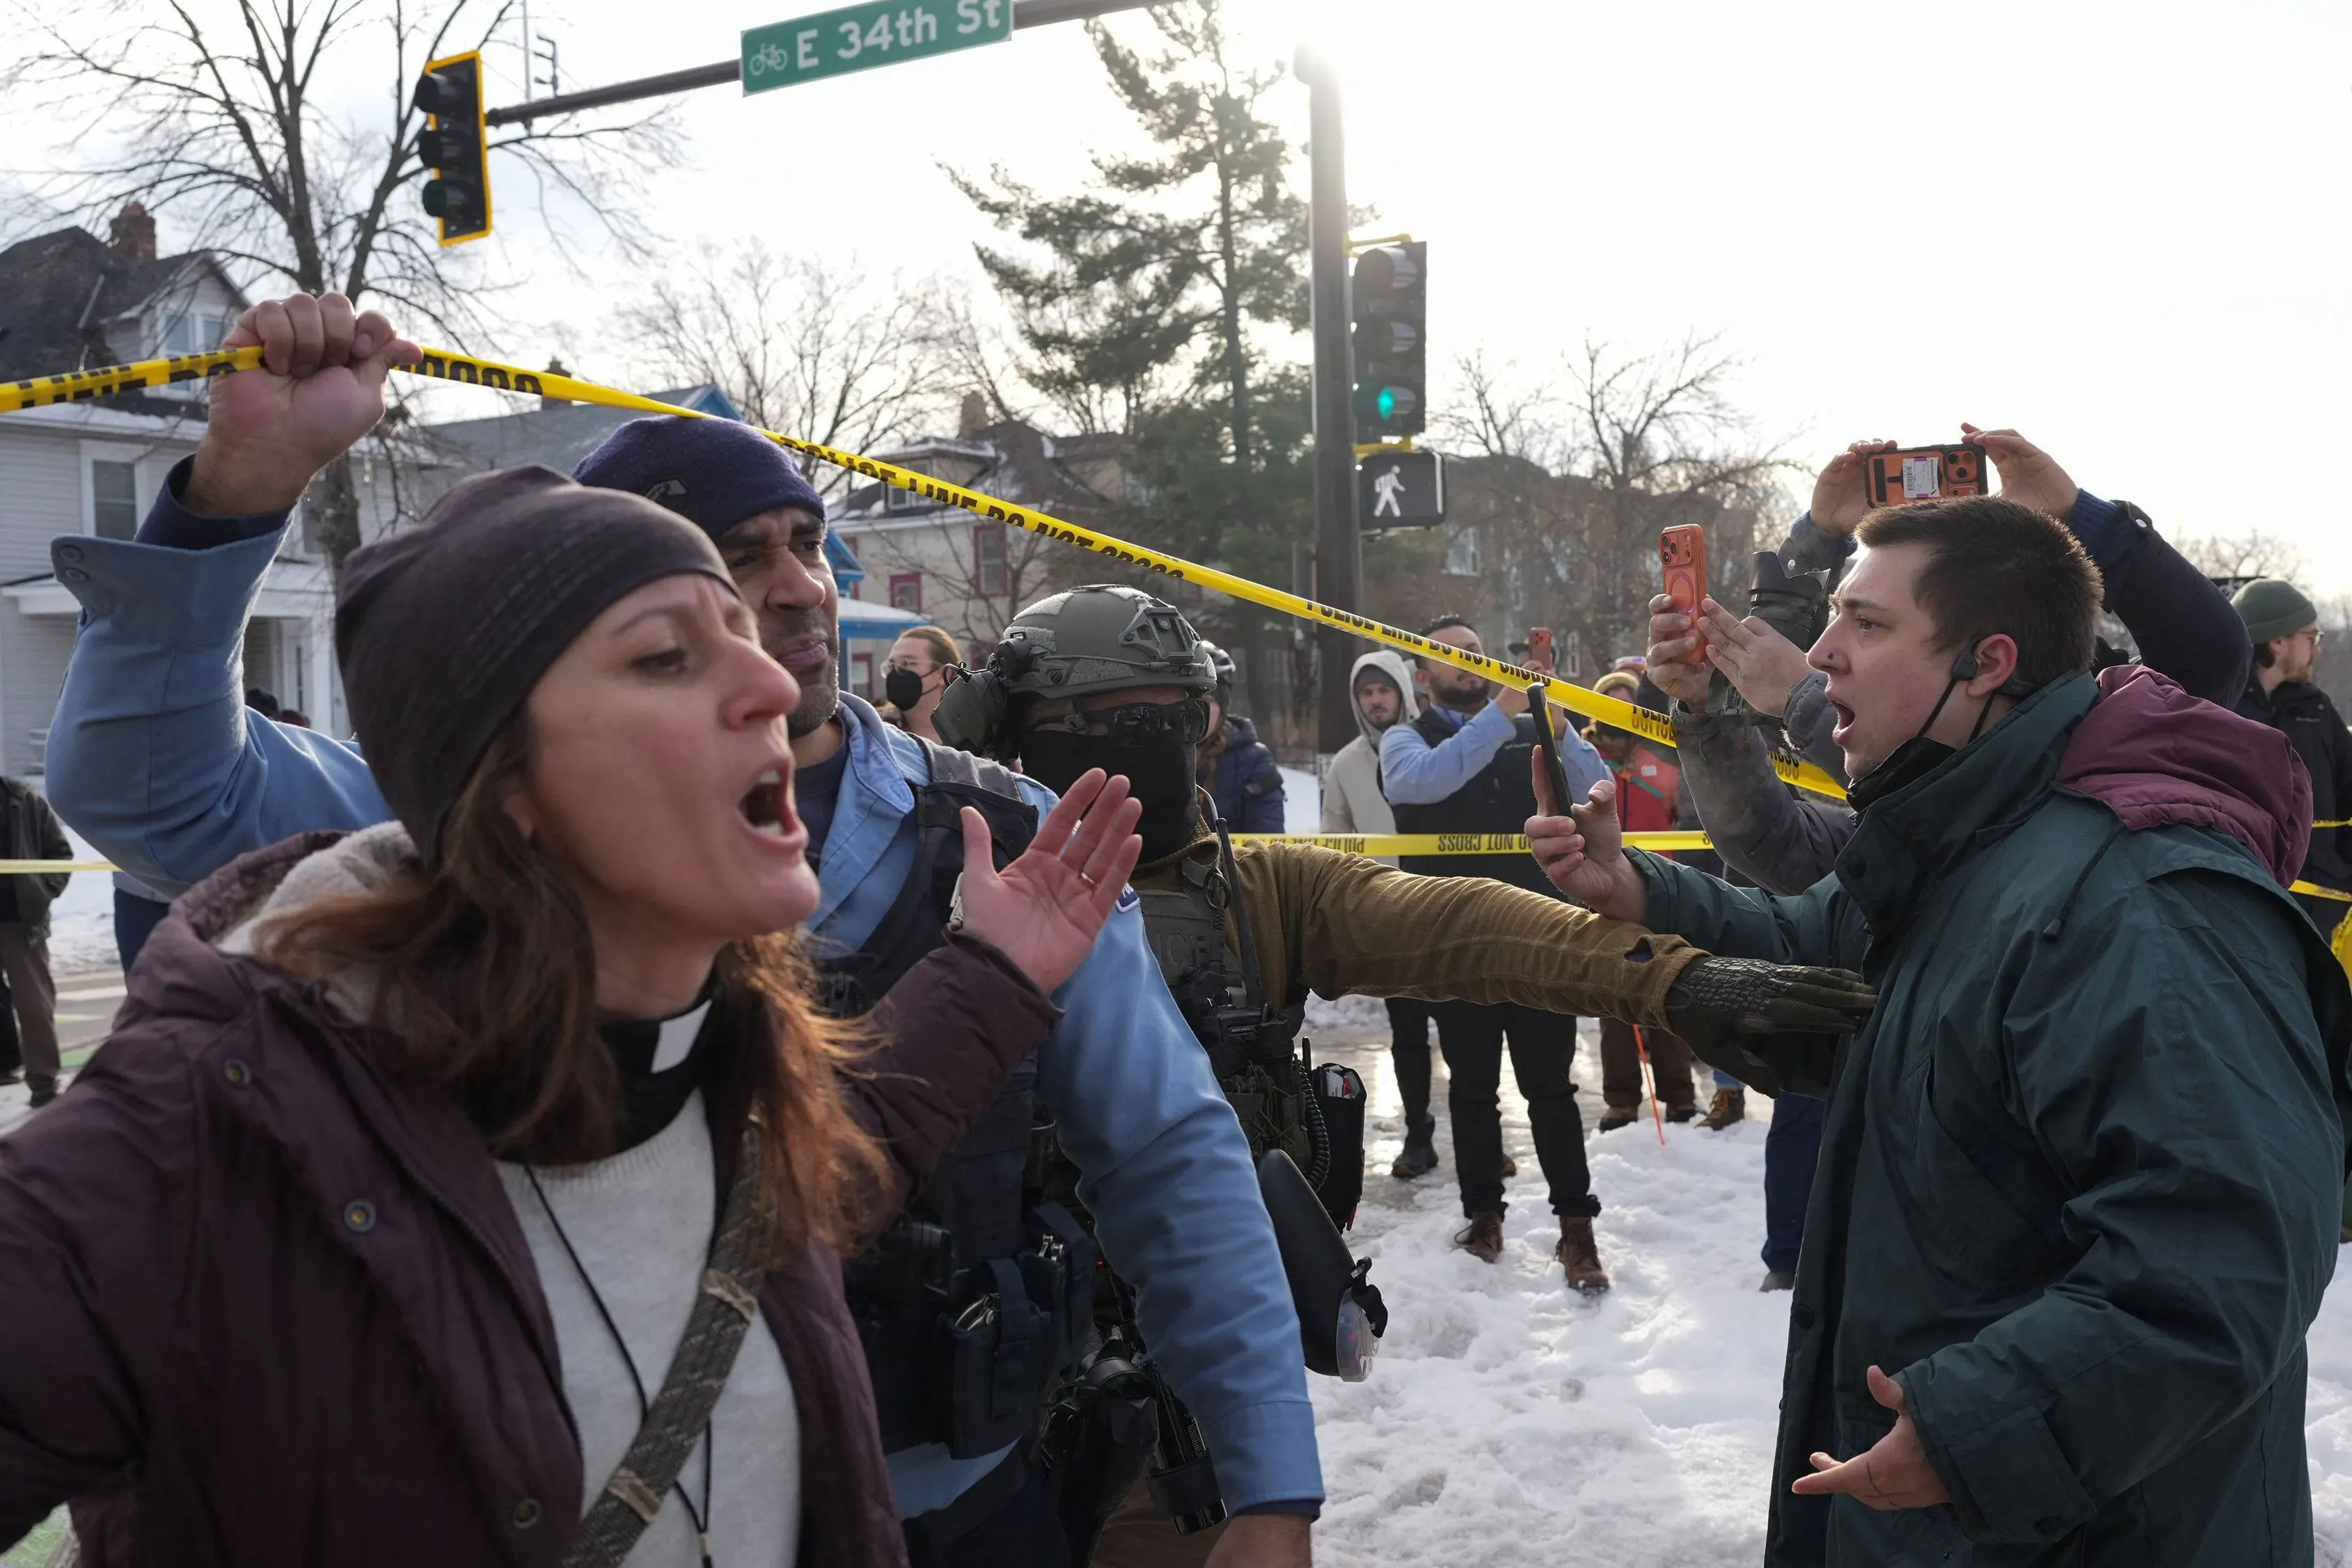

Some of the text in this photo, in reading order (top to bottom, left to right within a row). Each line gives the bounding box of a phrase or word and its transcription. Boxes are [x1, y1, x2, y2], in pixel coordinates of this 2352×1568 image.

[797, 0, 1001, 69] E 34th St
[1437, 835, 1482, 852] CROSS
